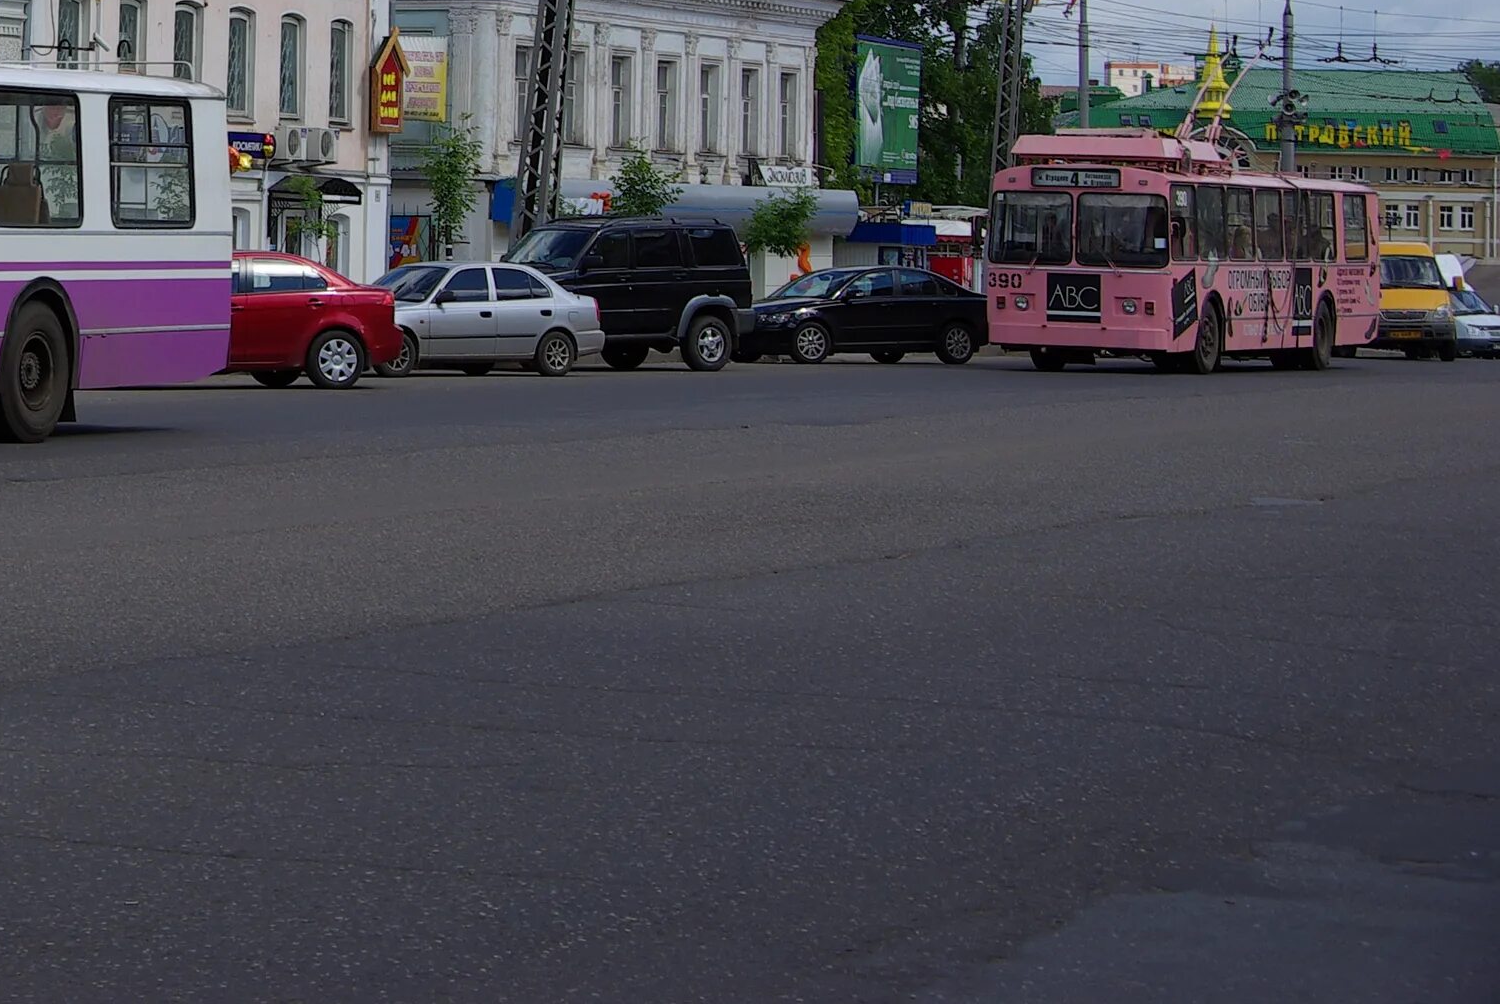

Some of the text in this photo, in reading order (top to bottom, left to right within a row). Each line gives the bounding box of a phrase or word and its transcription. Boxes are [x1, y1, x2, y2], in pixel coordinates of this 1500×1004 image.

[1265, 121, 1412, 147] ПТРОВСКИЙ
[1070, 172, 1079, 186] 4
[988, 272, 1022, 289] 390
[1228, 269, 1267, 290] ОГРОМНЫЙ
[1049, 283, 1099, 310] ABC
